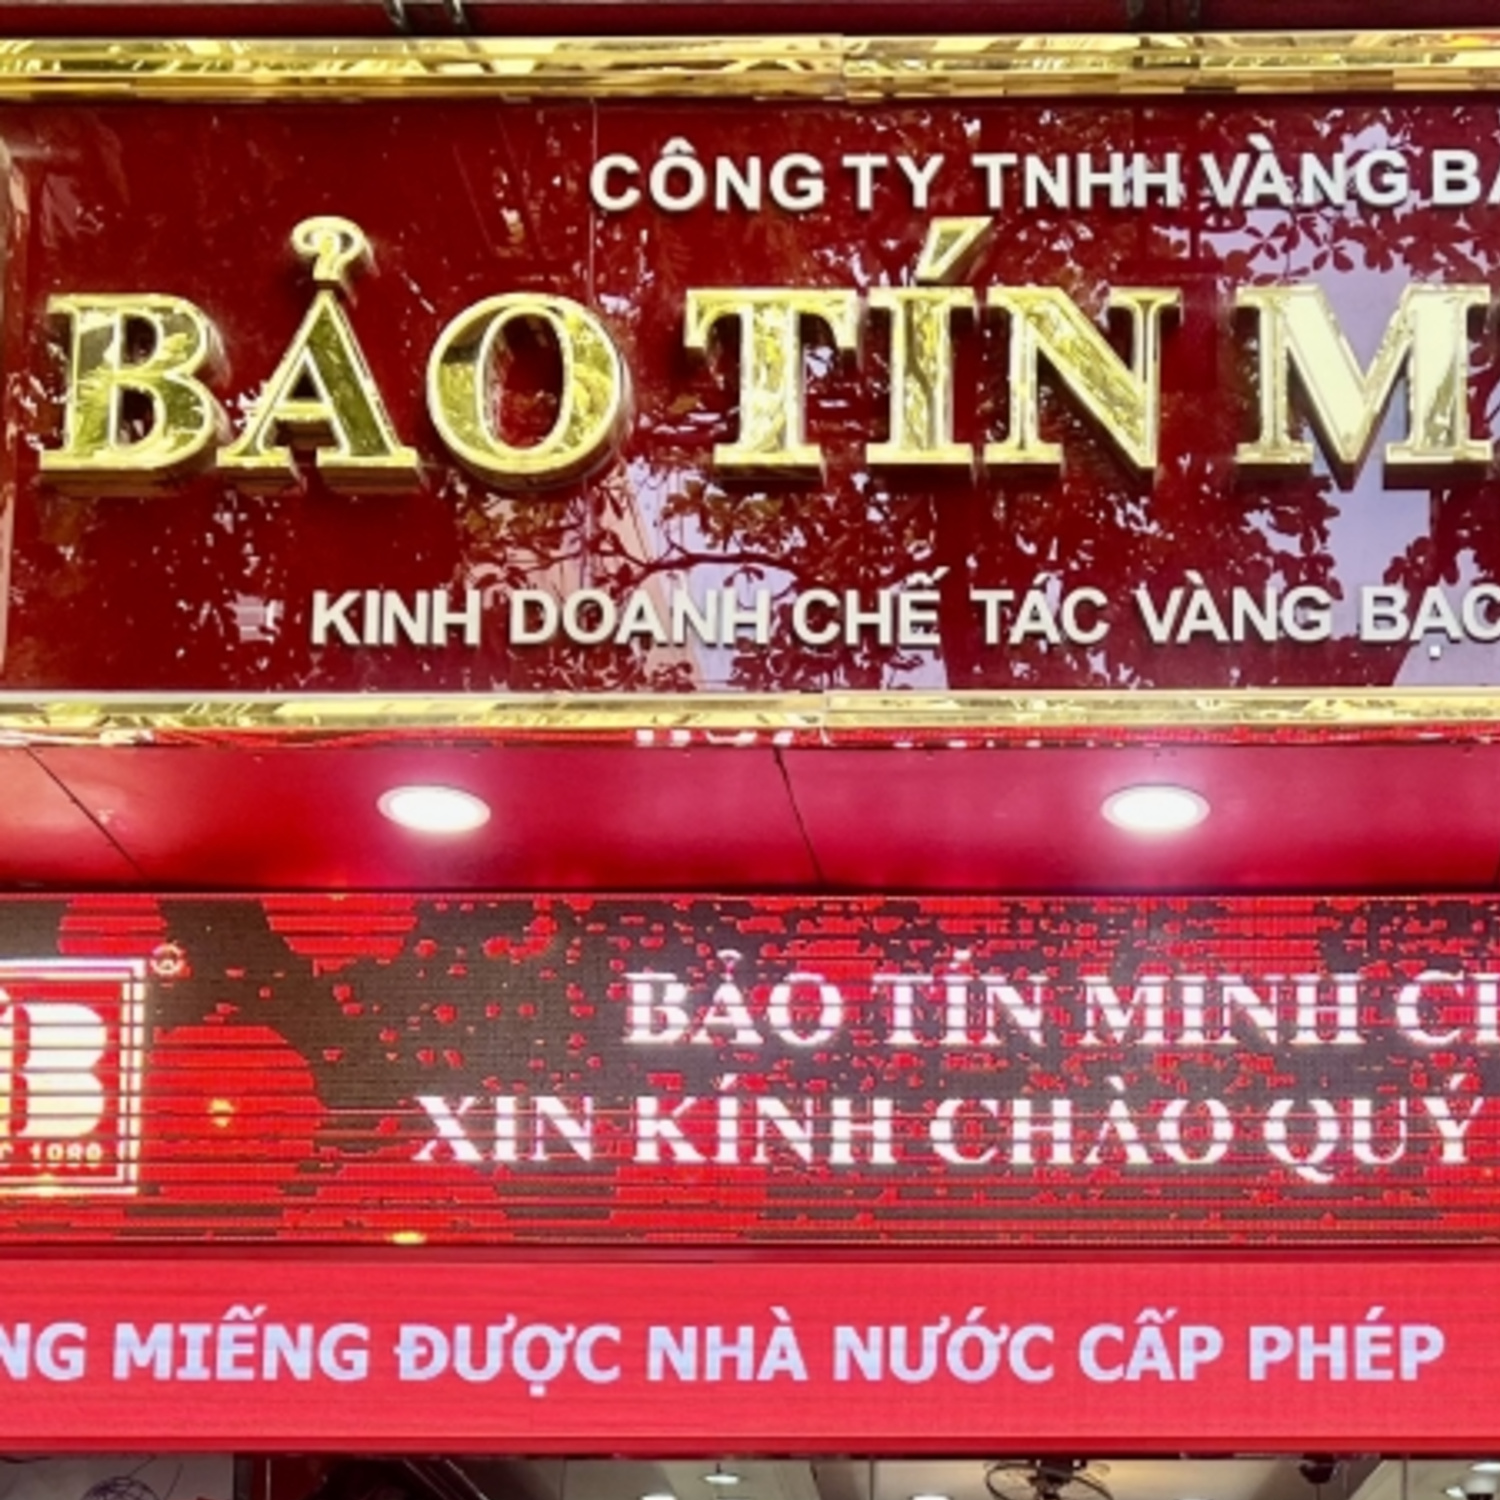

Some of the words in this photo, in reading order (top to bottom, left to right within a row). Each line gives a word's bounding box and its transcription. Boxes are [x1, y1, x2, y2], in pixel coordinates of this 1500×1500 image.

[590, 138, 826, 212] CÔNG
[844, 154, 945, 211] TY
[973, 153, 1182, 208] TNHH
[1201, 134, 1409, 207] VÀNG
[37, 216, 628, 488] BẢO
[684, 216, 1181, 478] TÍN
[311, 590, 481, 648] KINH
[509, 590, 774, 648] DOANH
[791, 568, 949, 648] CHẾ
[973, 576, 1110, 647] TÁC
[1135, 572, 1334, 645] VÀNG
[623, 949, 845, 1045] BẢO
[872, 948, 1048, 1046] TÍN
[1078, 971, 1367, 1045] MINH
[411, 1095, 595, 1164] XIN
[632, 1074, 898, 1164] KÍNH
[929, 1075, 1235, 1165] CHÀO
[1263, 1072, 1485, 1184] QUÝ
[112, 1304, 369, 1382] MIẾNG
[394, 1313, 622, 1397] ĐƯỢC
[647, 1306, 809, 1381] NHÀ
[832, 1306, 1055, 1383] NƯỚC
[1078, 1306, 1224, 1382] CẤP
[1248, 1306, 1445, 1382] PHÉP
